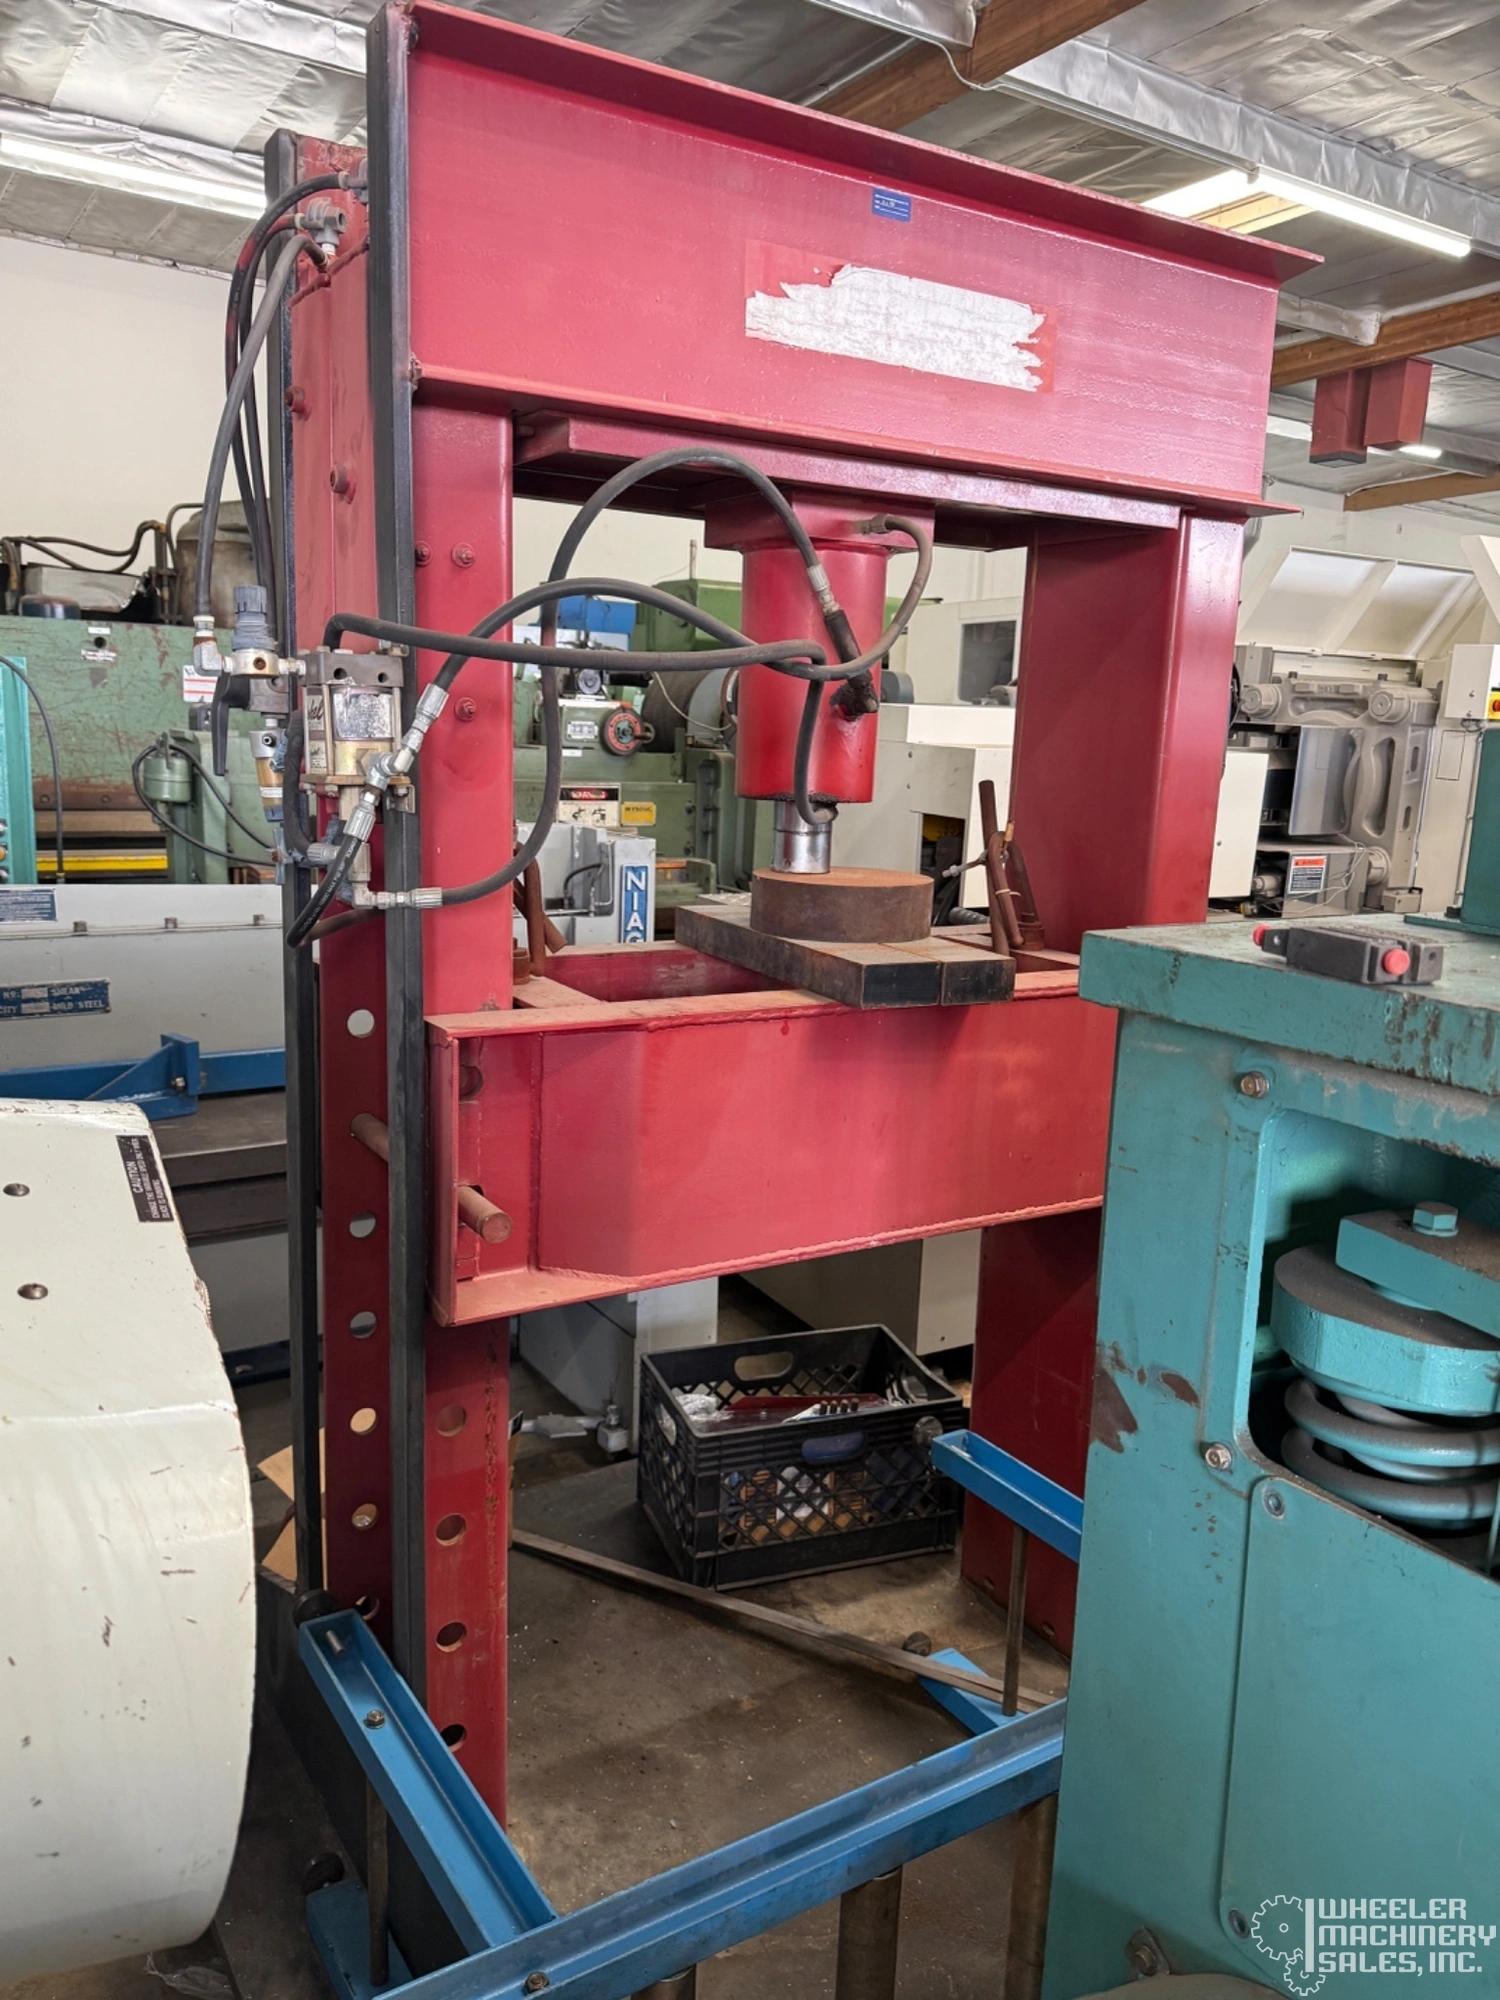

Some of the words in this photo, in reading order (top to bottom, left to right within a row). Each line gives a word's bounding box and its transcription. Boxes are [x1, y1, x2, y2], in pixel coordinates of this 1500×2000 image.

[78, 1000, 104, 1009] STEEL
[135, 1150, 143, 1159] ONLY
[125, 1161, 143, 1193] CAUTION
[145, 1192, 154, 1200] THE
